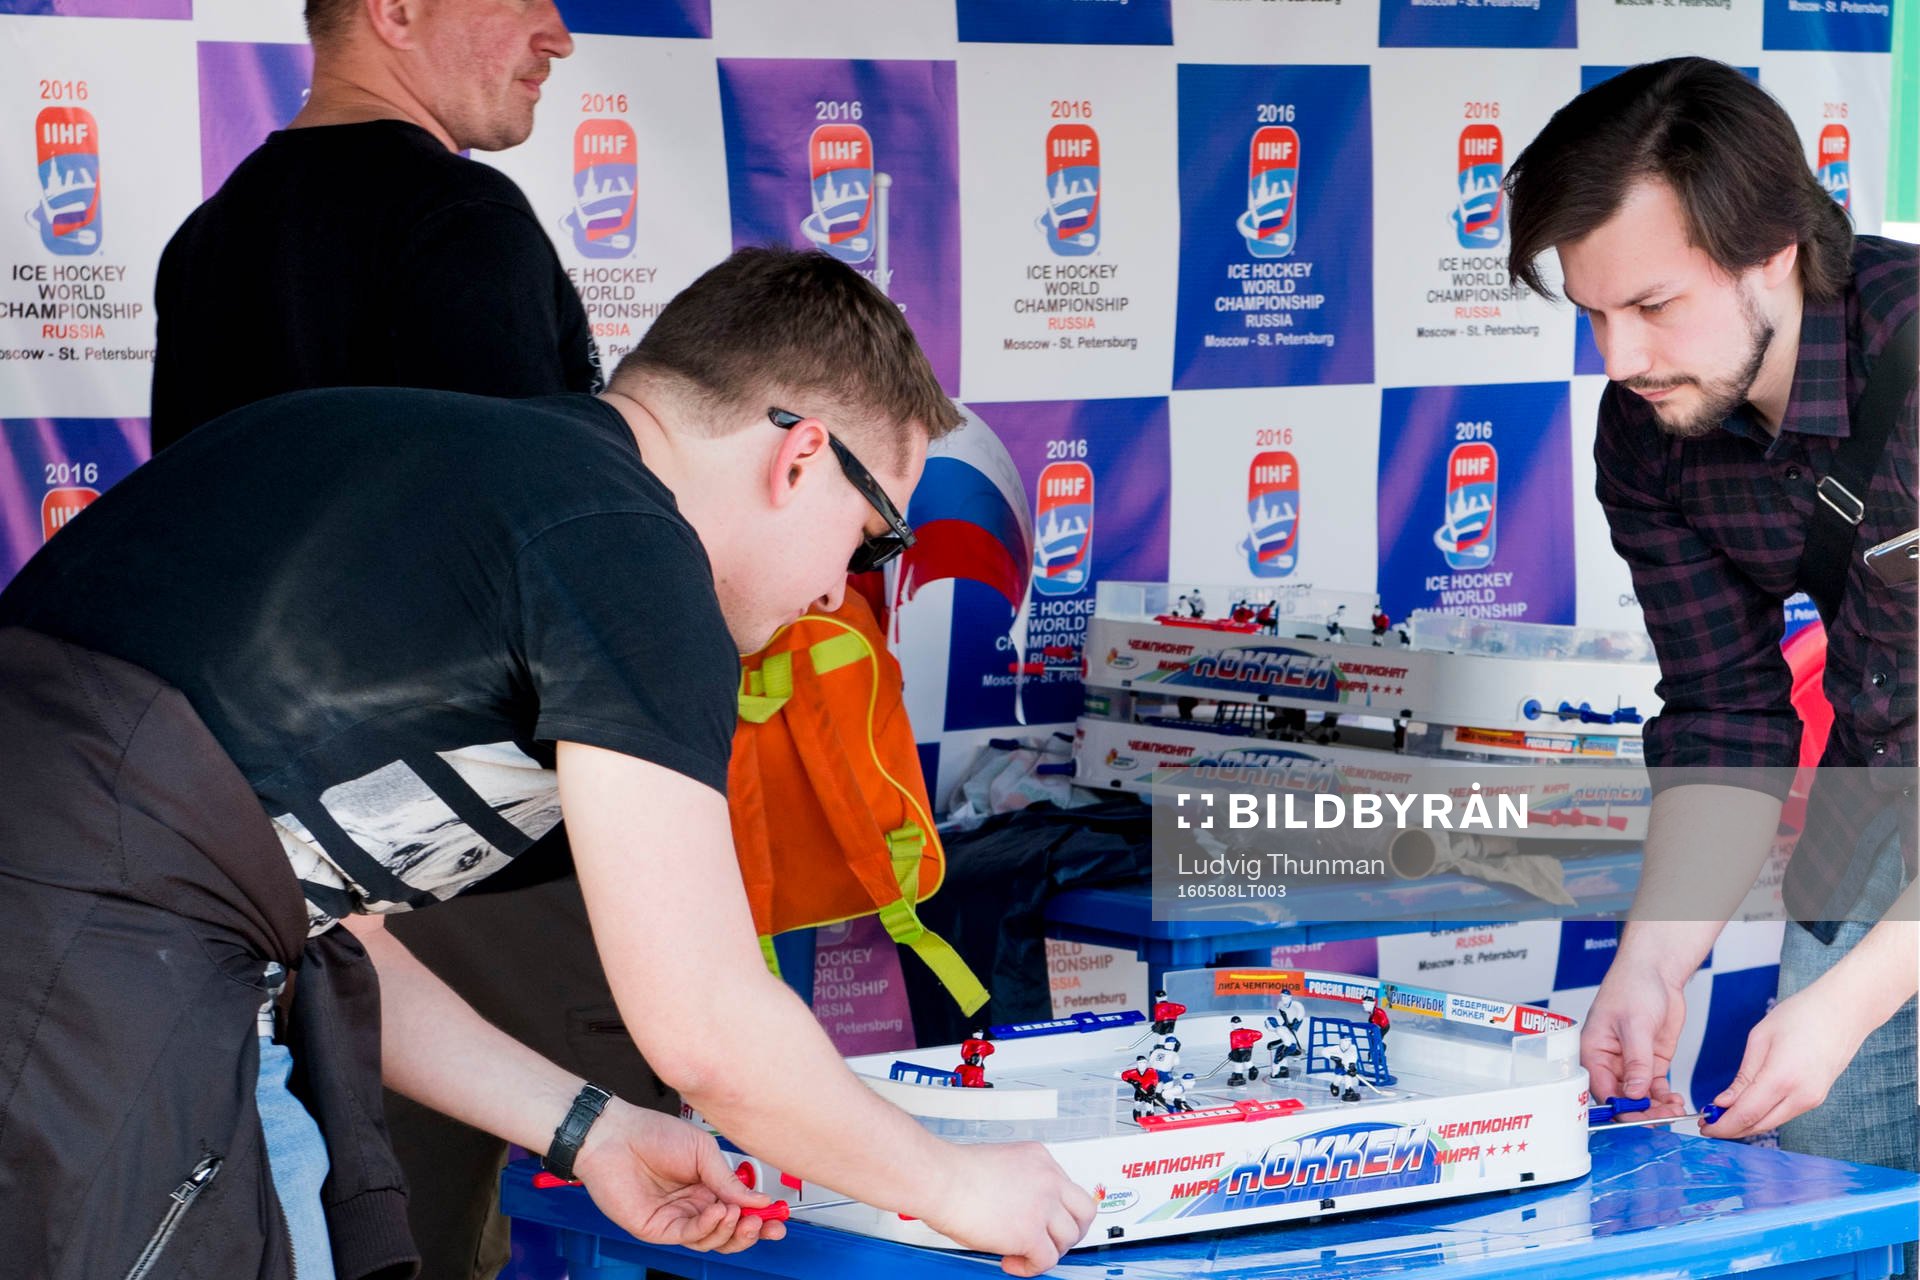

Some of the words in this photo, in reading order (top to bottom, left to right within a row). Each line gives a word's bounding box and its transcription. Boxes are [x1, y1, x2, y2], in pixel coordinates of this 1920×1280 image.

[39, 79, 89, 100] 2016
[581, 94, 628, 113] 2016
[815, 101, 863, 120] 2016
[1051, 100, 1092, 118] 2016
[1464, 102, 1500, 119] 2016
[1257, 104, 1295, 122] 2016
[44, 123, 89, 144] IIHF
[583, 135, 629, 154] IIHF
[819, 141, 863, 160] IIHF
[1053, 139, 1092, 158] IIHF
[1258, 142, 1292, 160] IIHF
[1464, 138, 1497, 155] IIHF
[1027, 265, 1051, 280] ICE
[1056, 264, 1118, 280] HOCKEY
[1228, 265, 1250, 279] ICE
[1252, 263, 1312, 278] HOCKEY
[1438, 257, 1458, 271] ICE
[13, 265, 47, 281] ICE
[53, 265, 127, 282] HOCKEY
[583, 268, 657, 283] HOCKEY
[1452, 273, 1504, 286] WORLD
[38, 284, 106, 301] WORLD
[1045, 281, 1099, 296] WORLD
[1242, 280, 1296, 295] WORLD
[1014, 297, 1129, 313] CHAMPIONSHIP
[1215, 295, 1325, 312] CHAMPIONSHIP
[1245, 313, 1293, 328] RUSSIA
[1455, 306, 1501, 319] RUSSIA
[42, 324, 105, 339] RUSSIA
[588, 322, 630, 337] SSIA
[1048, 317, 1096, 330] RUSSIA
[1416, 326, 1457, 338] Moscow
[1484, 325, 1540, 338] Petersburg
[1003, 338, 1050, 350] Moscow
[1060, 337, 1074, 349] St.
[1078, 336, 1138, 351] Petersburg
[1204, 335, 1249, 347] Moscow
[1257, 334, 1274, 346] St.
[1275, 333, 1335, 347] Petersburg
[59, 347, 79, 360] St.
[1256, 429, 1293, 446] 2016
[1456, 422, 1492, 440] 2016
[1046, 440, 1088, 458] 2016
[45, 463, 98, 484] 2016
[1255, 465, 1292, 483] IIHF
[1455, 457, 1490, 476] IIHF
[1047, 478, 1085, 497] IIHF
[1426, 576, 1448, 591] ICE
[1451, 572, 1513, 589] HOCKEY
[1441, 589, 1496, 604] WORLD
[1041, 600, 1095, 617] HOCKE
[1029, 617, 1085, 633] WORLD
[1128, 639, 1195, 656] ЧЕМПИОНАТ
[1193, 649, 1334, 690] ХОККЕЙ
[1338, 661, 1409, 679] ЧЕМПИОНАТ
[1128, 739, 1196, 757] ЧЕМПИОНАТ
[1193, 750, 1336, 793] ХОККЕЙ
[1455, 934, 1494, 949] RUSSIA
[817, 948, 872, 967] OCKEY
[1418, 960, 1455, 971] Moscow
[1478, 949, 1528, 962] Petersburg
[1051, 976, 1081, 991] SSIA
[1218, 982, 1241, 991] ЛИГА
[1242, 981, 1300, 991] ЧЕМПИОНОВ
[1064, 992, 1127, 1008] Petersburg
[1390, 991, 1445, 1012] СУПЕРКУБОК
[1452, 998, 1505, 1014] ФЕДЕРАЦИЯ
[1451, 1007, 1485, 1021] ХОККЕЯ
[836, 1019, 903, 1033] Petersburg
[1121, 1152, 1225, 1179] ЧЕМПИОНАТ
[1227, 1119, 1432, 1195] ХОККЕЙ
[1437, 1114, 1533, 1140] ЧЕМПИОНАТ
[1170, 1178, 1220, 1199] МИРА
[1433, 1145, 1480, 1166] МИРА
